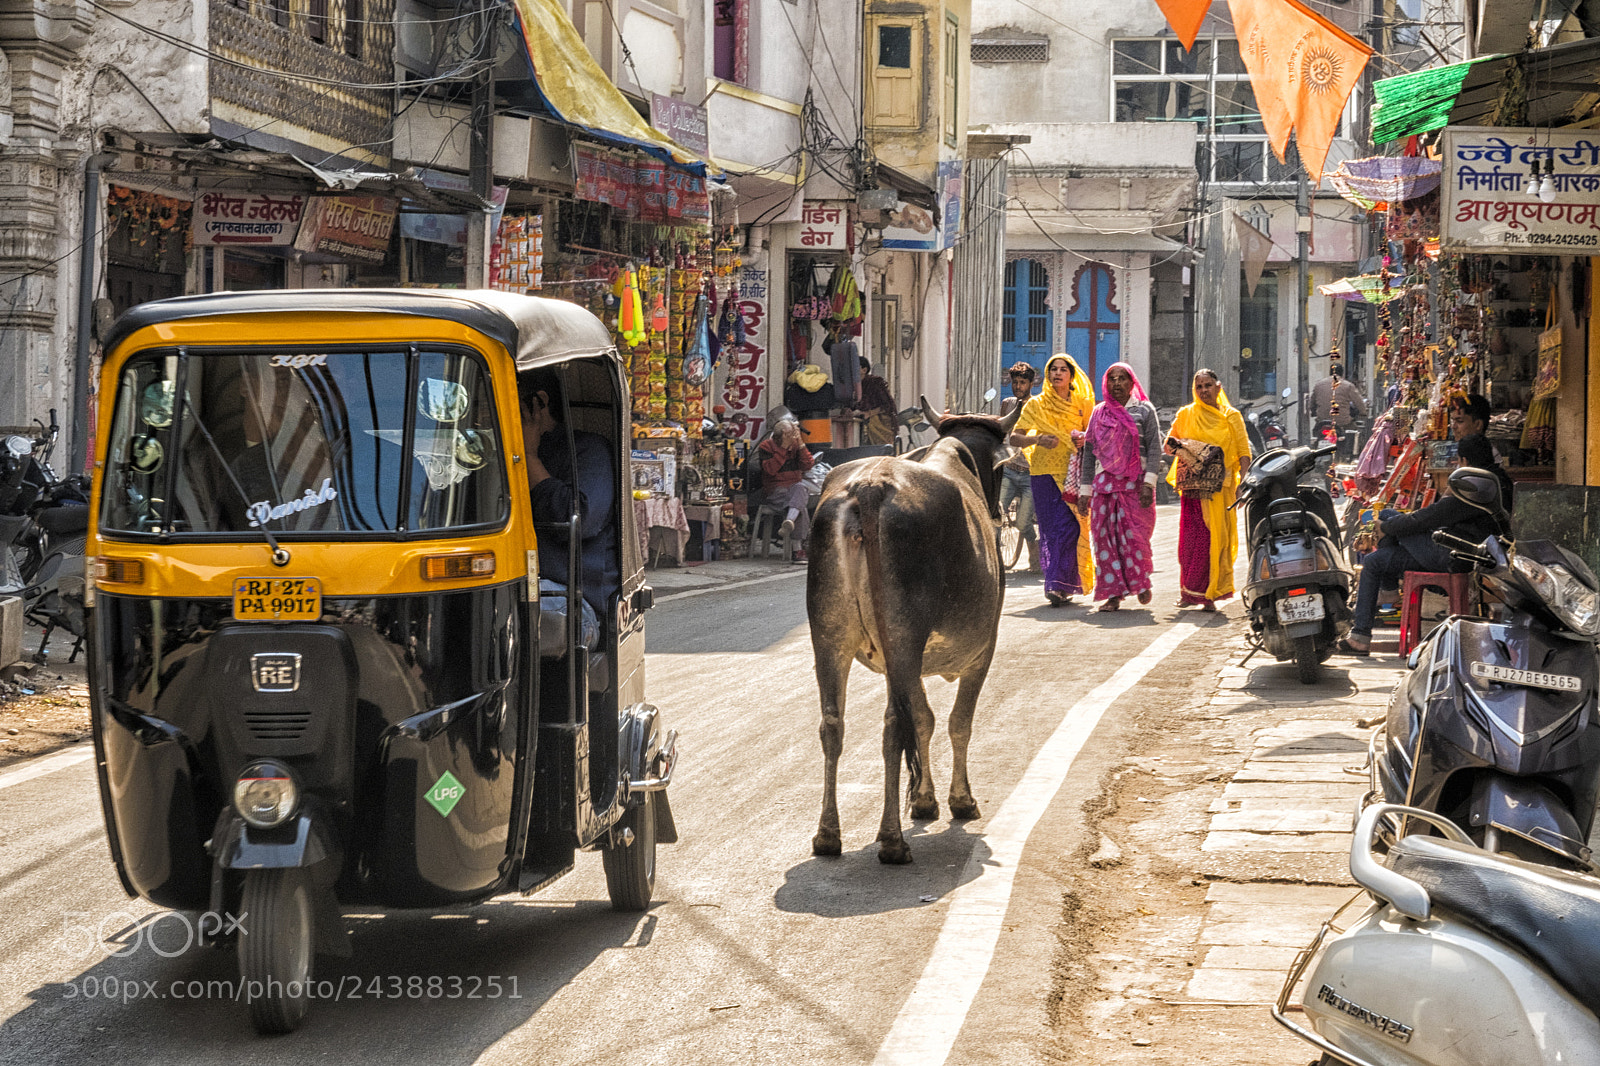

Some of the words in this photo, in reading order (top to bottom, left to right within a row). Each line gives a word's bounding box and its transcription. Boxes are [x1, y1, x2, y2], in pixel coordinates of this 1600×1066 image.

[202, 192, 247, 218] भैरव
[800, 226, 834, 246] बेग
[246, 477, 338, 528] Danish
[248, 580, 272, 596] RJ
[281, 580, 305, 596] 27
[240, 598, 266, 613] PA
[271, 598, 316, 613] 9917
[1492, 666, 1574, 688] RJ27BE9565
[434, 786, 458, 802] LPG
